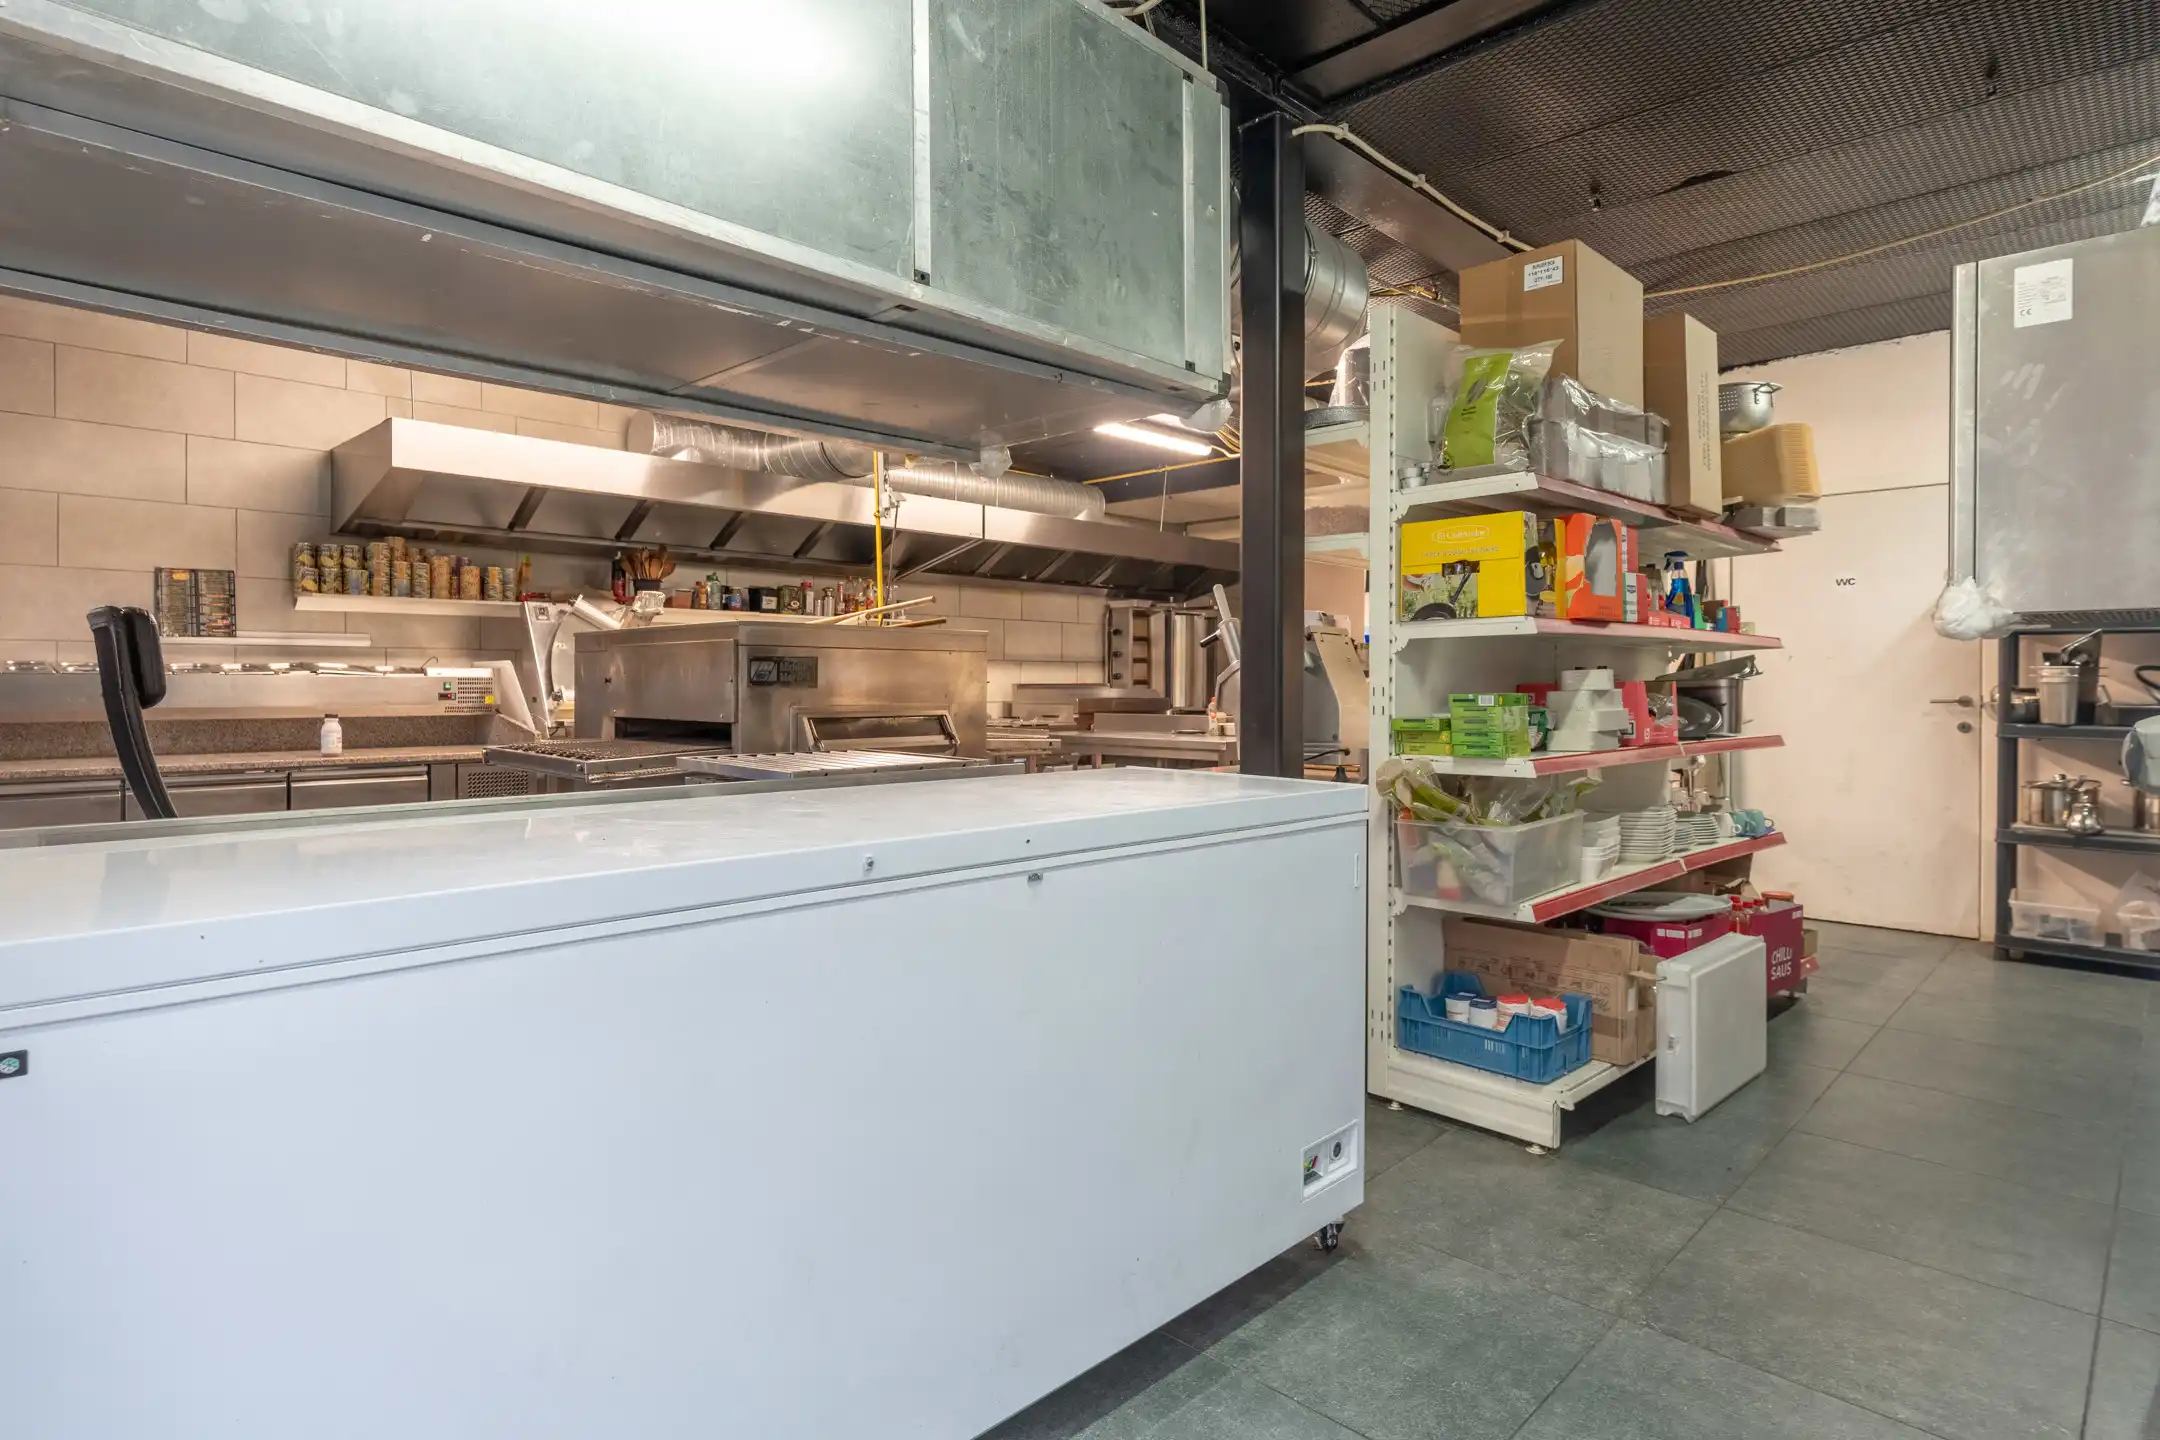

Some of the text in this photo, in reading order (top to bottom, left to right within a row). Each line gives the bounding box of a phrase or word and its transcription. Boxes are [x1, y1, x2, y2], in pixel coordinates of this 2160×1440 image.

[1835, 578, 1856, 586] WC
[1771, 946, 1793, 965] CHILLI
[1771, 962, 1792, 980] SAUS
